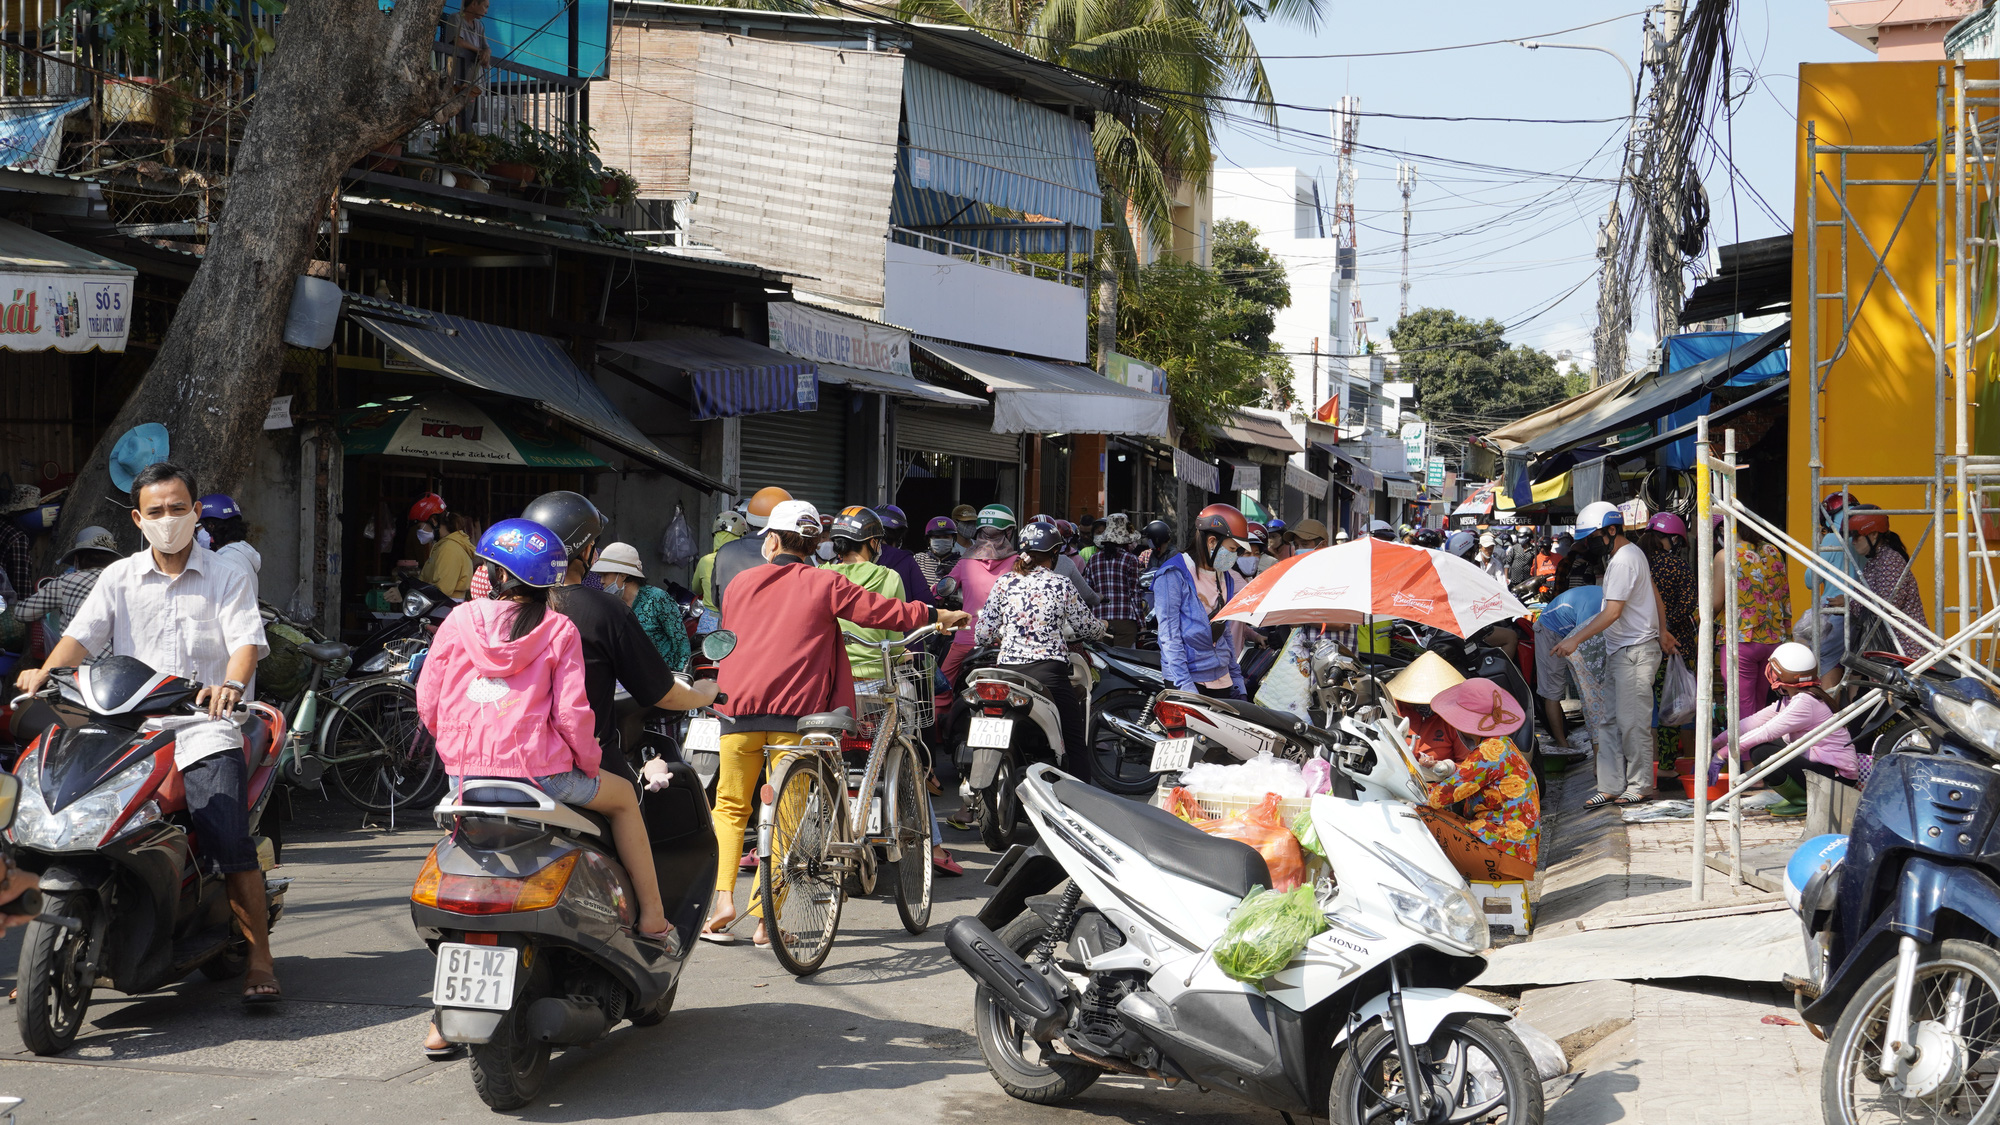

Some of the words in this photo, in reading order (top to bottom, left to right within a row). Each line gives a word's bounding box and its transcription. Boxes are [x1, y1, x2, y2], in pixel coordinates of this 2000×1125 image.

[96, 285, 110, 310] SỐ
[114, 293, 121, 310] 5
[0, 288, 41, 334] át
[816, 323, 833, 360] GIÀY
[835, 327, 851, 363] DÉP
[421, 423, 484, 441] KPU
[1295, 586, 1347, 597] Budweiser
[1393, 593, 1434, 612] Budweiser
[976, 720, 1006, 733] 72-C1
[1159, 740, 1187, 756] 72-L8
[1156, 755, 1185, 770] 0440
[1930, 776, 1981, 791] HONDA
[1485, 859, 1502, 881] D&G
[1328, 935, 1370, 956] HONDA
[448, 949, 505, 977] 61-N2
[445, 976, 501, 1005] 5521
